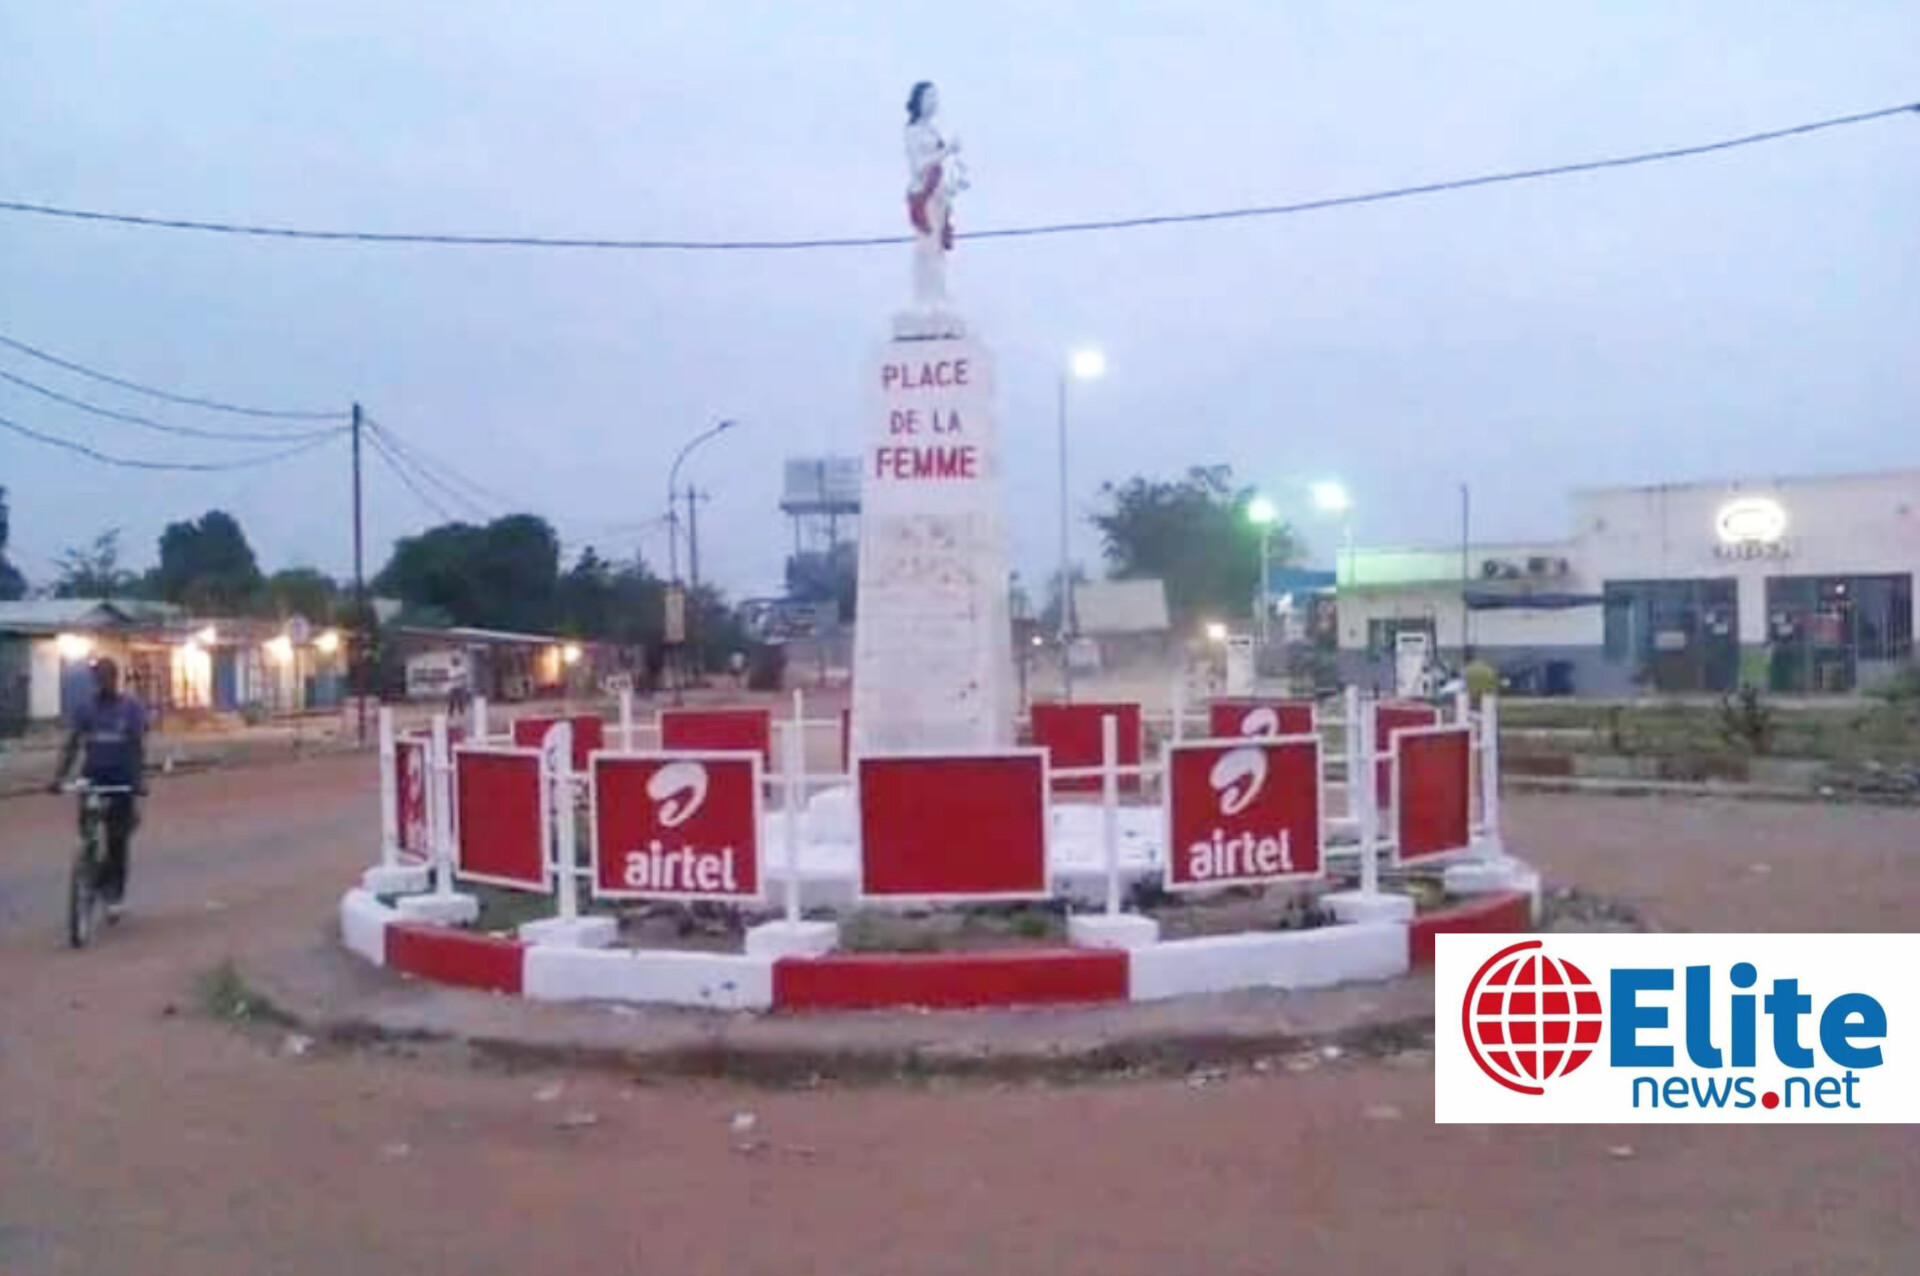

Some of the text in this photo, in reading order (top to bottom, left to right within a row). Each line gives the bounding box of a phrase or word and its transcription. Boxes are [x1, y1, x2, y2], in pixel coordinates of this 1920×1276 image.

[882, 360, 968, 390] PLACE
[891, 409, 962, 434] DE LA
[876, 446, 977, 479] FEMME
[624, 839, 737, 890] airtel
[1188, 828, 1293, 878] airtel
